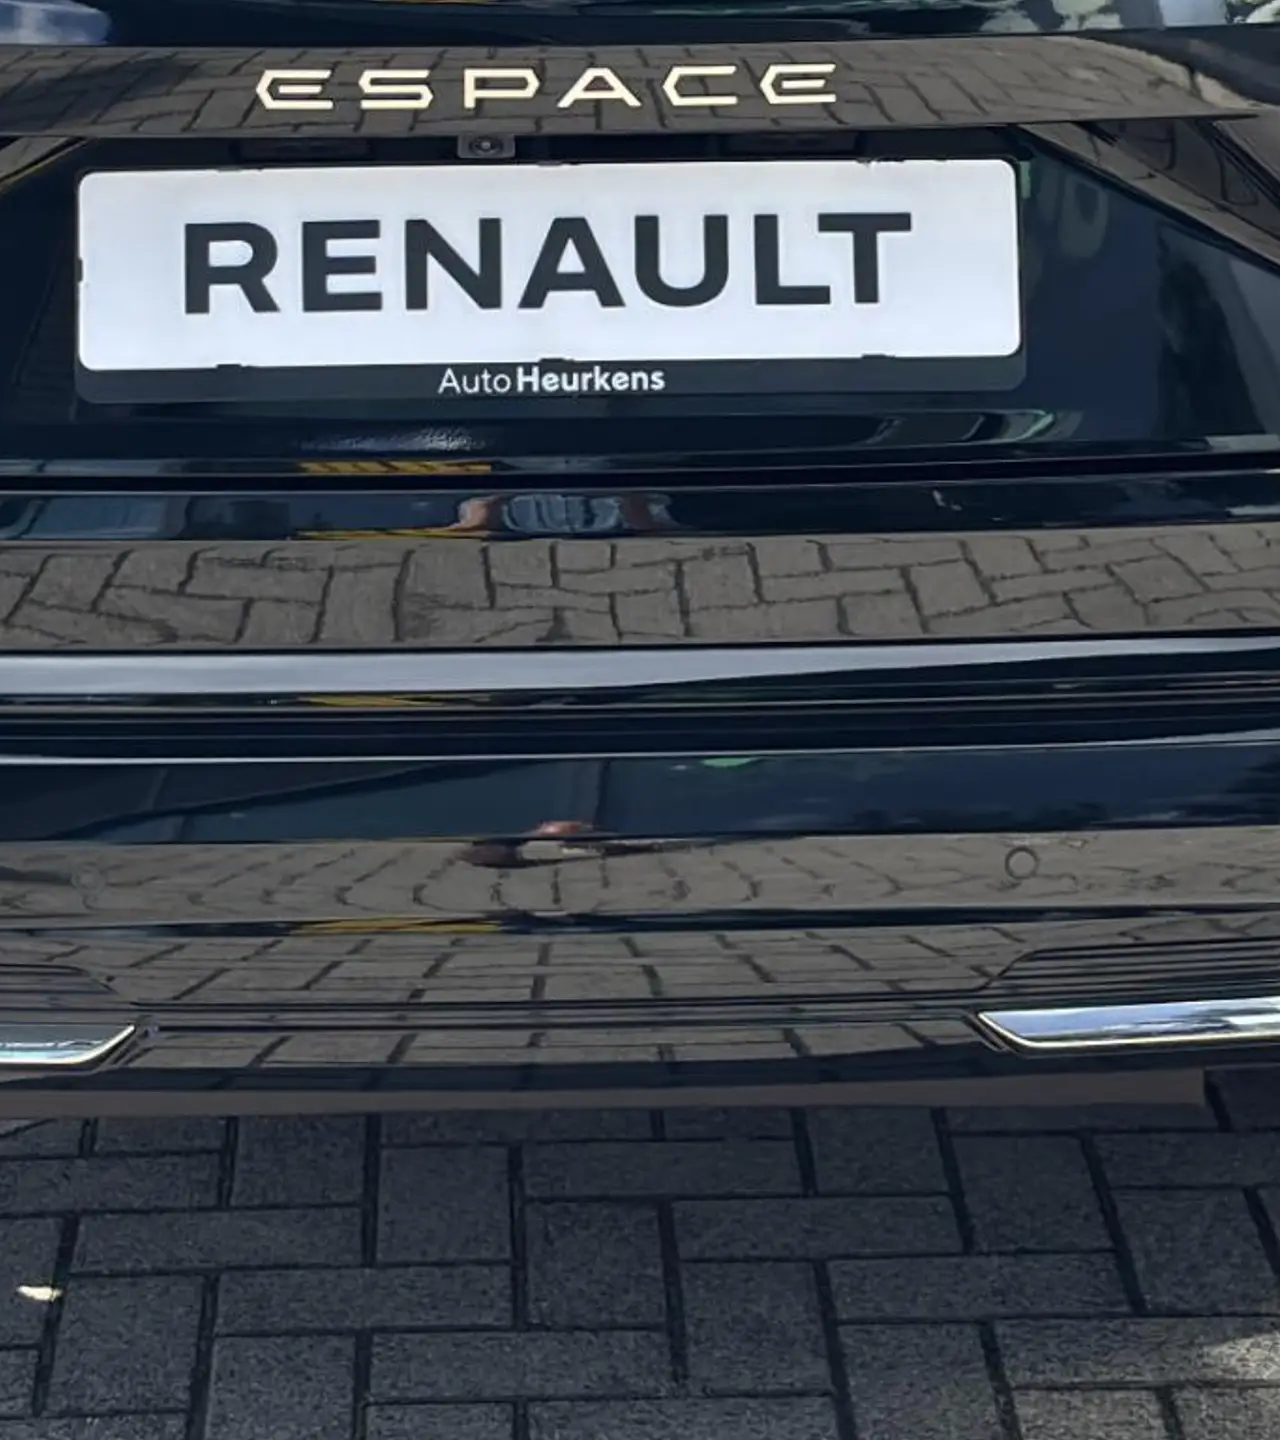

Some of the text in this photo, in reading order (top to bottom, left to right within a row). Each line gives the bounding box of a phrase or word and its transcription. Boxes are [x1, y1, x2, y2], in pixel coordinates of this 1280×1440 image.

[256, 63, 837, 111] ESPACE
[184, 212, 912, 315] RENAULT
[439, 365, 665, 396] Auto Heurkens
